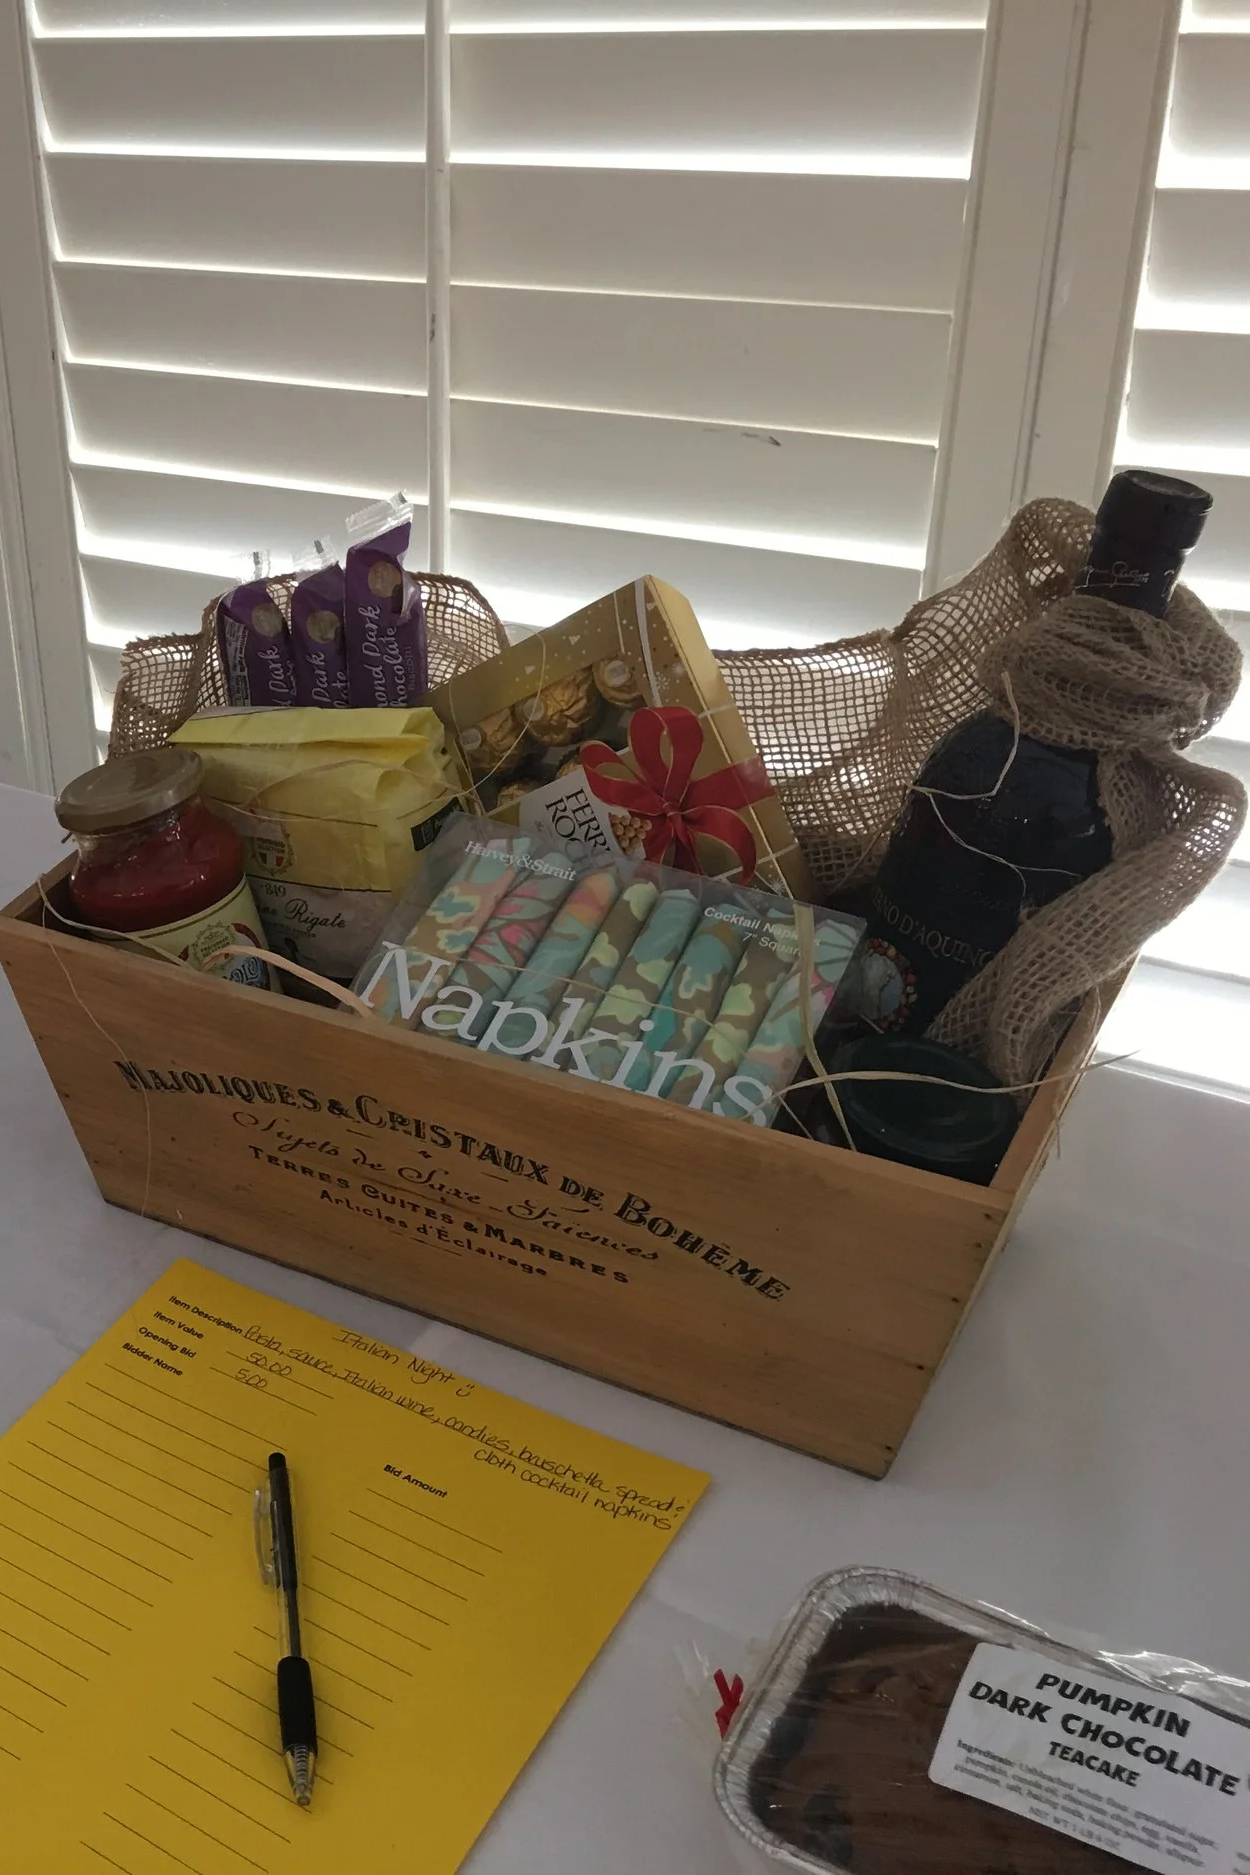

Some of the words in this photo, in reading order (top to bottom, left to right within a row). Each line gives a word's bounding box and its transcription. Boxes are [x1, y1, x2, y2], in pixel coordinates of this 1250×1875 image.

[358, 604, 382, 657] Dark
[258, 645, 284, 694] Dark
[306, 651, 330, 702] Dark
[379, 626, 408, 707] hocolate
[566, 787, 611, 851] FERR
[464, 839, 578, 883] Harvey&Strait
[284, 897, 348, 930] Rigate
[703, 906, 761, 930] Cocktail
[762, 922, 821, 947] Napks
[359, 941, 773, 1128] Napkins
[248, 1145, 350, 1189] TERRES
[361, 1183, 454, 1225] CUITES
[463, 1220, 479, 1234] &
[484, 1223, 629, 1284] MARBRES
[319, 1189, 408, 1229] Articles
[559, 1175, 604, 1211] DE
[153, 1310, 175, 1327] Item
[176, 1323, 204, 1340] Value
[168, 1295, 191, 1314] Item
[191, 1304, 243, 1335] Description
[122, 1342, 153, 1362] Bidder
[154, 1357, 184, 1378] Name
[138, 1326, 180, 1353] Opening
[180, 1345, 197, 1360] Bid
[332, 1328, 400, 1365] Italian
[406, 1356, 457, 1386] Night
[383, 1463, 401, 1478] Bid
[402, 1474, 449, 1499] Amount
[593, 1494, 673, 1531] napkins
[1035, 1672, 1192, 1739] PUMPKIN
[968, 1680, 1054, 1724] DARK
[1060, 1712, 1241, 1797] CHOCOLATE
[1048, 1740, 1141, 1788] TEACAKE
